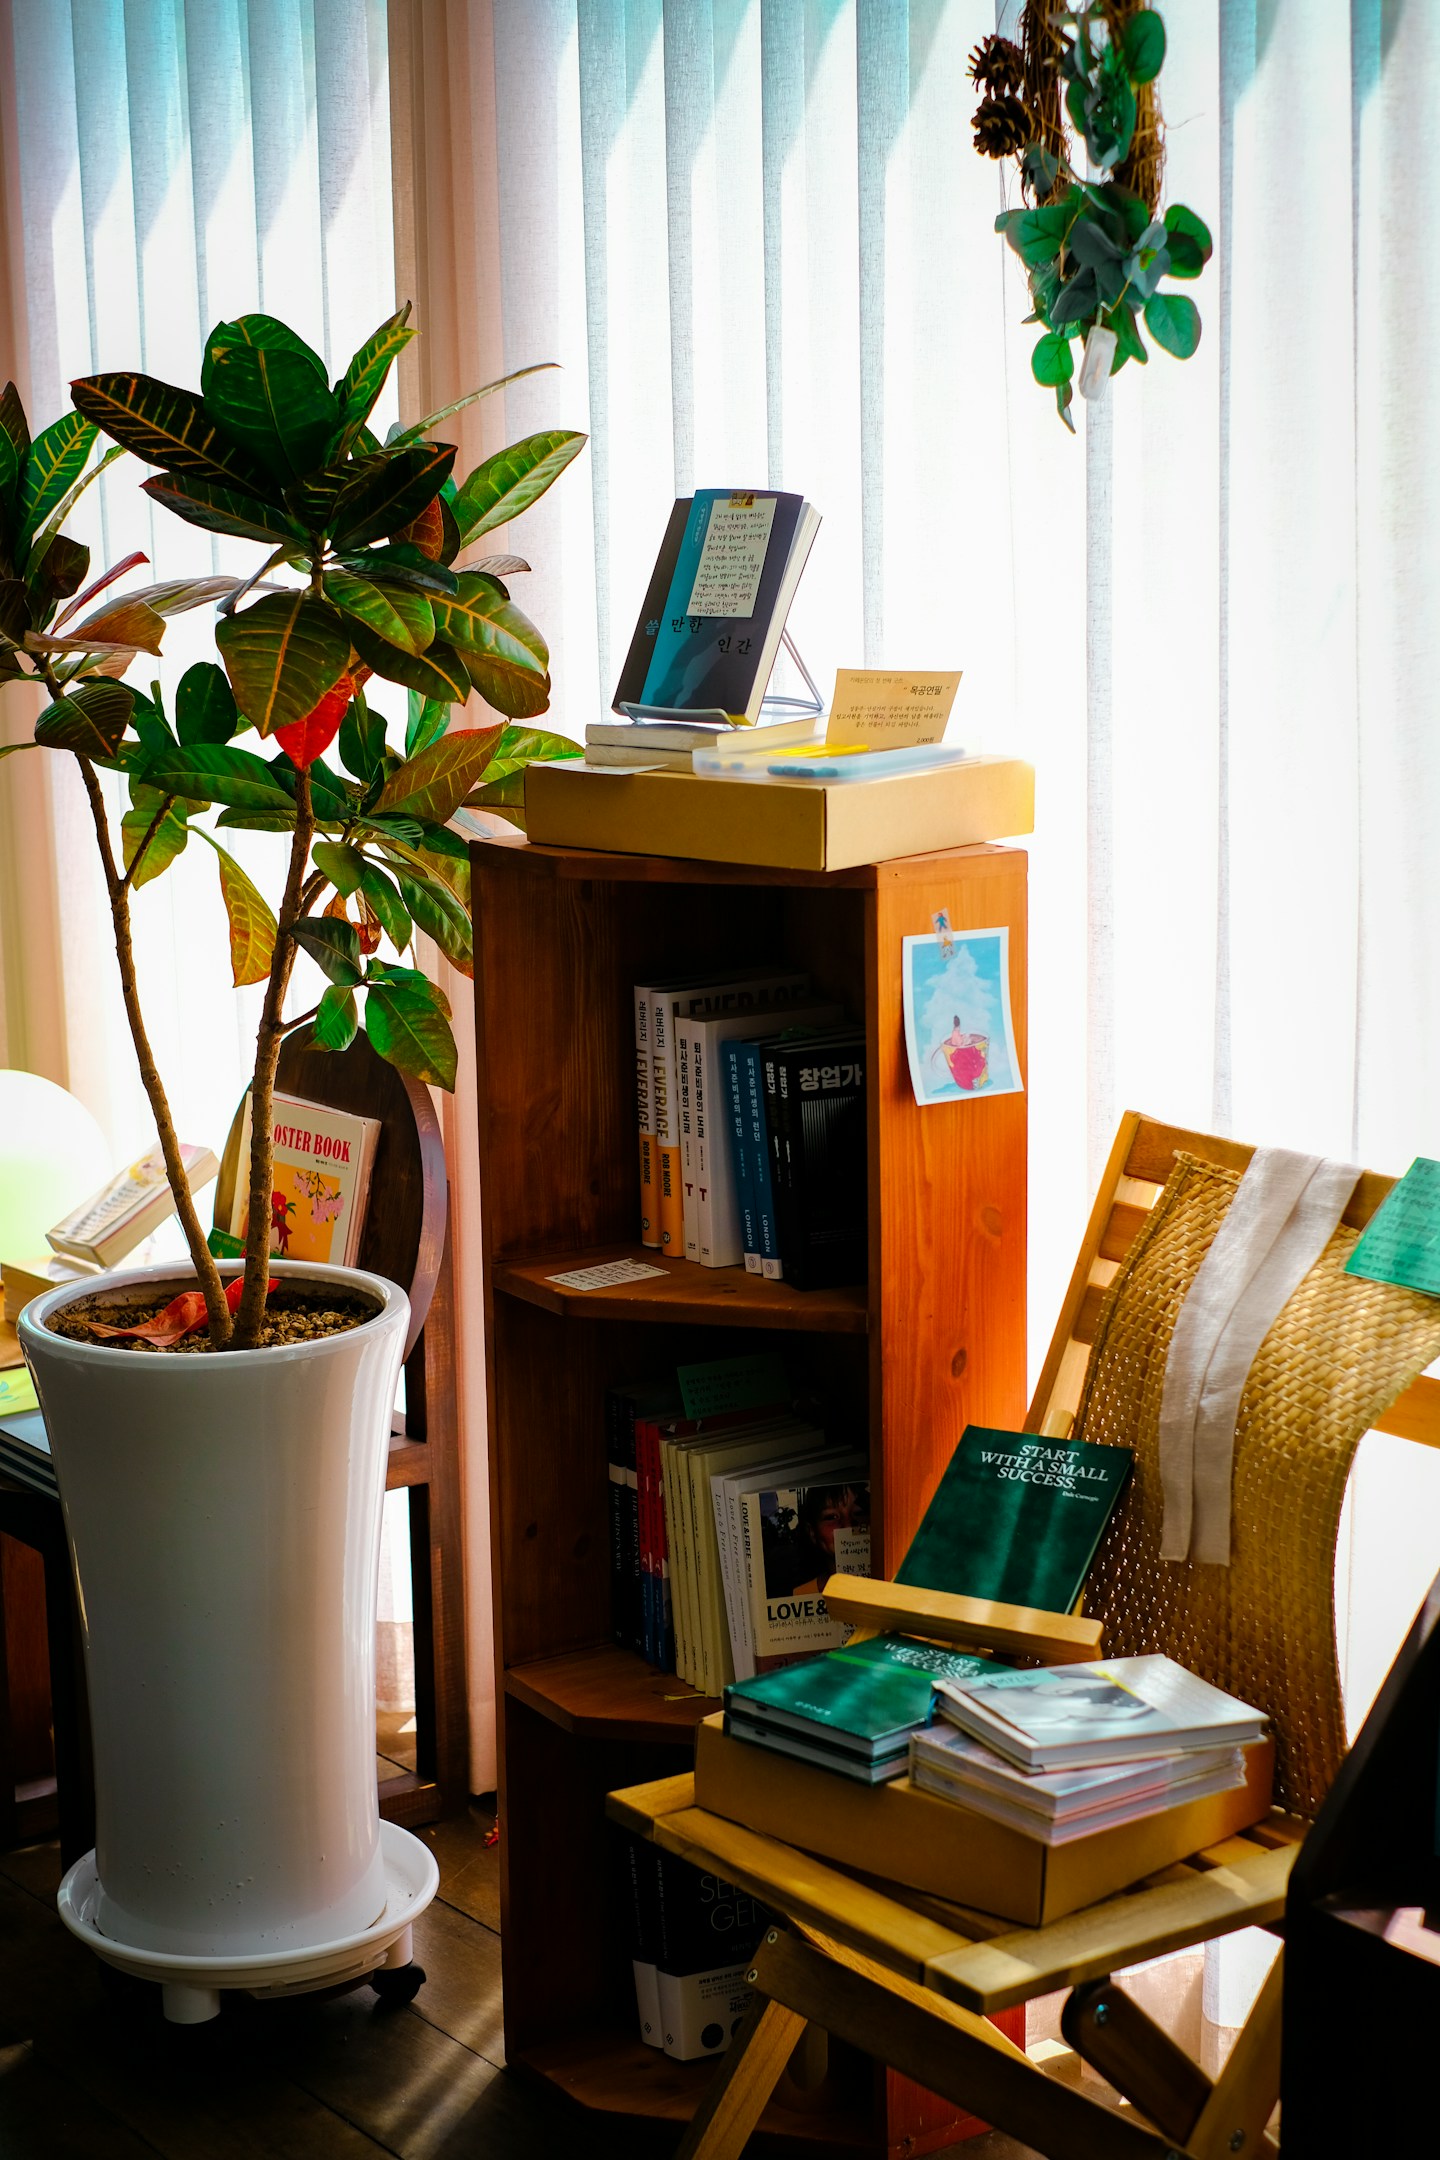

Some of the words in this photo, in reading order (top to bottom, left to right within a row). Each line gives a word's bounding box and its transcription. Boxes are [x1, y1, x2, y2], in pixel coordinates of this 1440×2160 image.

[645, 619, 660, 636] 쓸
[718, 636, 752, 655] 인간
[639, 1001, 648, 1042] 레버리지
[655, 1007, 665, 1048] 레버리지
[636, 1049, 650, 1132] LEVERAGE
[799, 1063, 863, 1092] 창업가
[653, 1055, 669, 1139] LEVERAGE
[273, 1124, 312, 1153] OSTER
[313, 1133, 352, 1163] BOOK
[643, 1156, 651, 1185] MOORE
[662, 1154, 670, 1170] ROB
[663, 1169, 672, 1198] MOORE
[744, 1209, 753, 1247] LONDON
[762, 1214, 770, 1253] LONDON
[981, 1451, 1032, 1469] WITH
[1031, 1459, 1044, 1471] A
[1048, 1461, 1109, 1482] SMALL
[1019, 1444, 1080, 1463] START
[997, 1466, 1077, 1490] SUCCESS.
[728, 1496, 736, 1520] Love
[719, 1530, 727, 1554] Free
